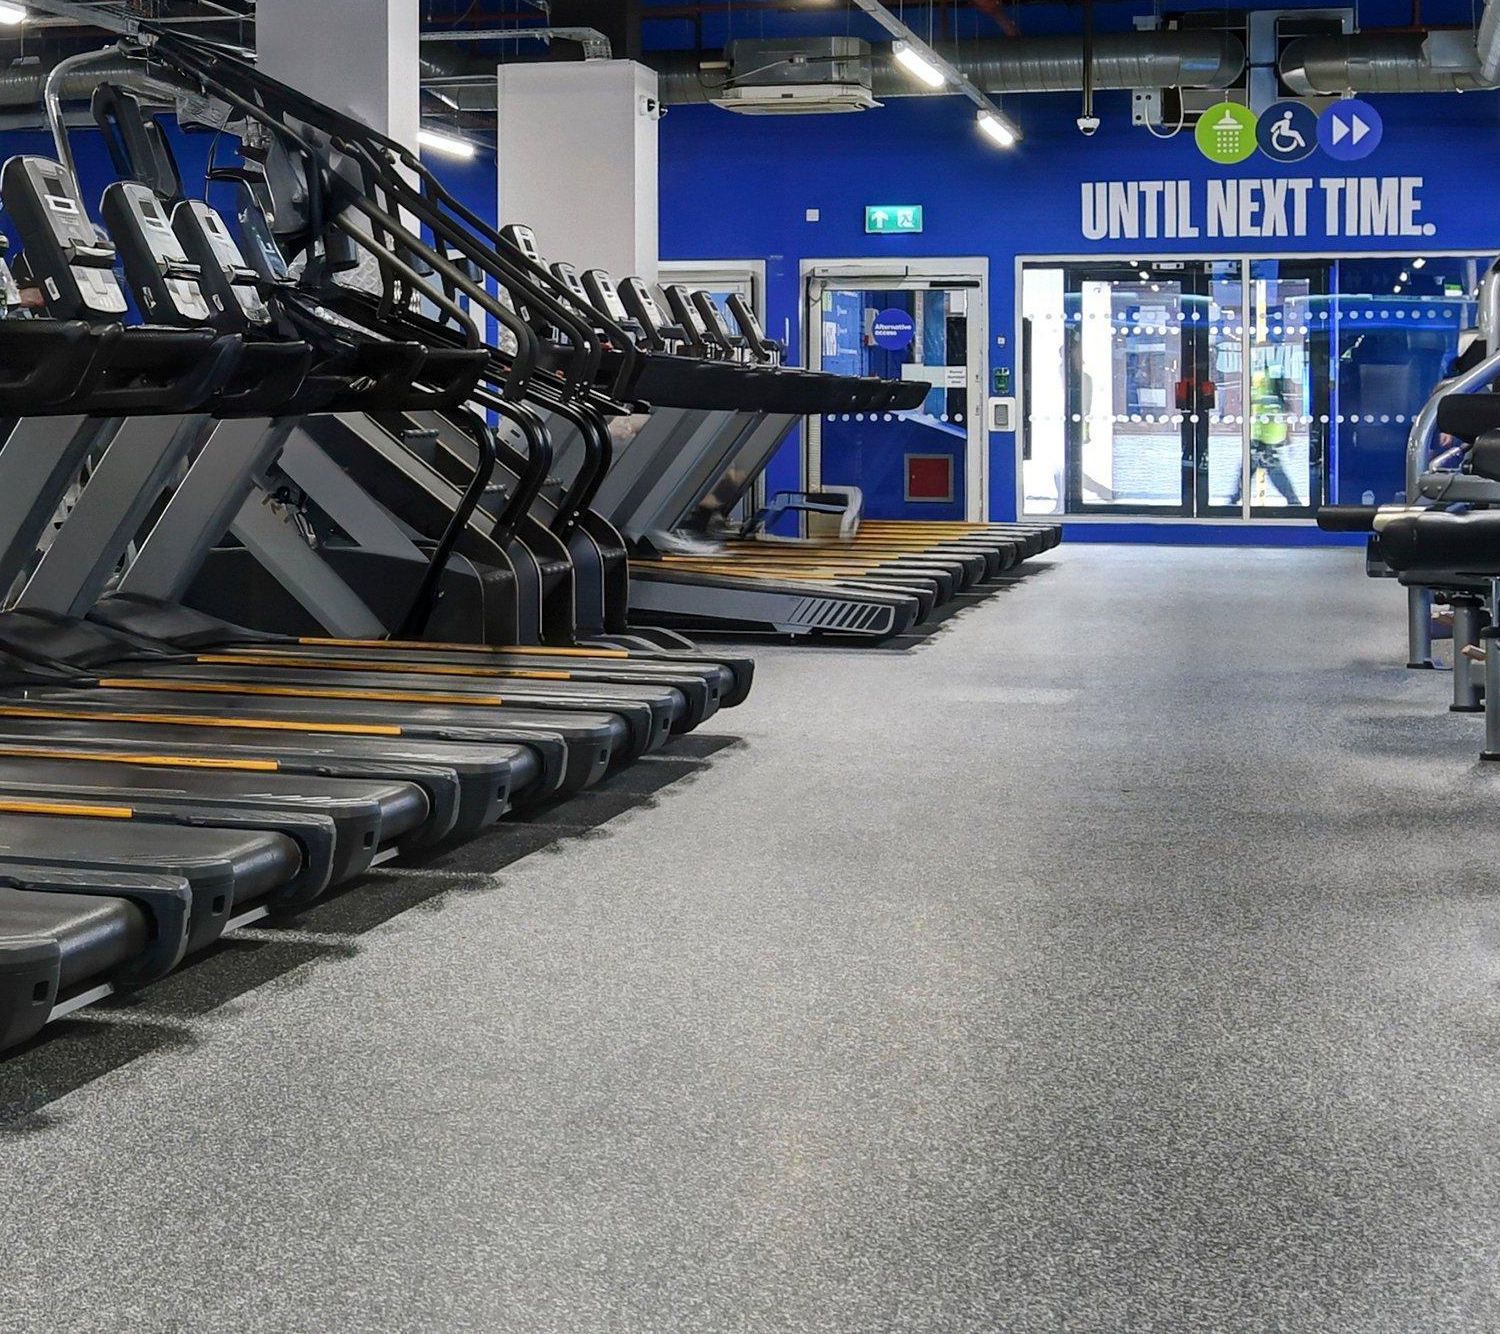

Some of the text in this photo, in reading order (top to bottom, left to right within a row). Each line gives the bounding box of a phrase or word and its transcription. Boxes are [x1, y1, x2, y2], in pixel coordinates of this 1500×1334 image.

[1081, 177, 1436, 240] UNTIL NEXT TIME.
